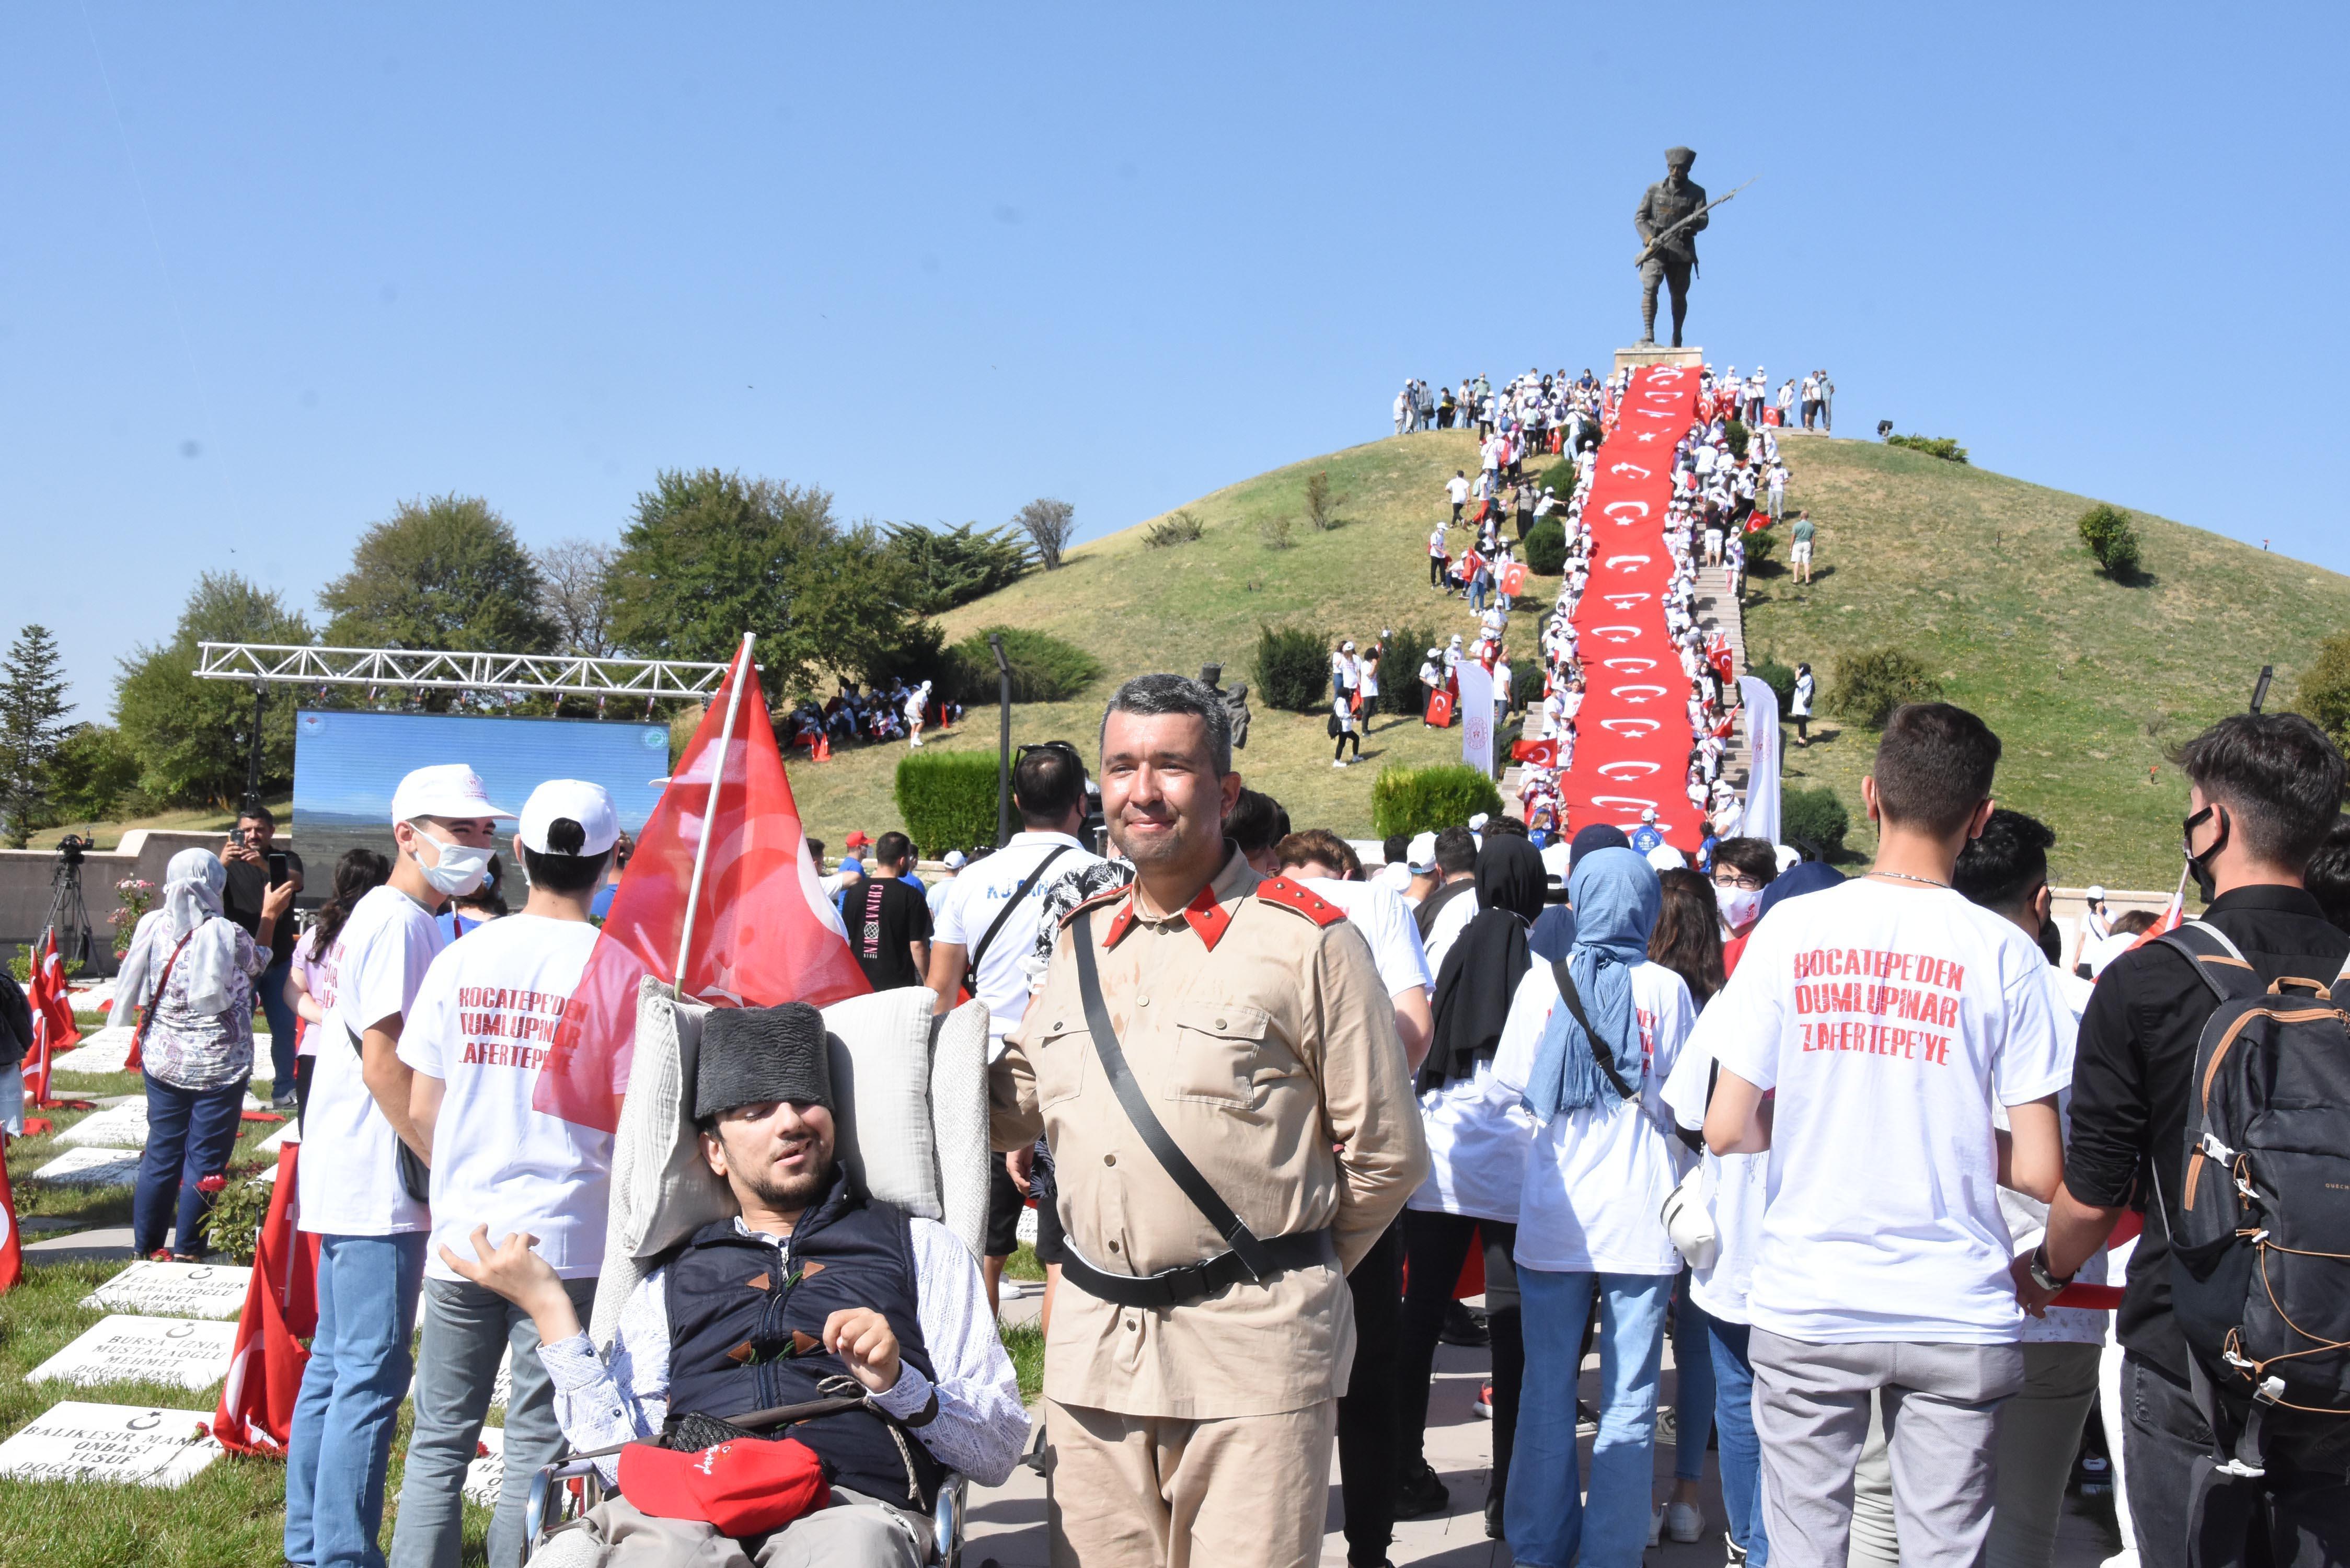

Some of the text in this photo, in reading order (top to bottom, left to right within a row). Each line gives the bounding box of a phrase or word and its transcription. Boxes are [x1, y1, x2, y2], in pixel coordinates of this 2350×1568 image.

[1793, 948, 1965, 991] KOCATEPE'DEN
[1795, 983, 1959, 1029] DUMLUPINAR
[1800, 1022, 1951, 1066] ZAFERTEPE'YE
[194, 1280, 249, 1289] MADEN
[138, 1293, 198, 1303] AHMET
[103, 1356, 183, 1367] MEHMET
[67, 1452, 137, 1465] YUSUF
